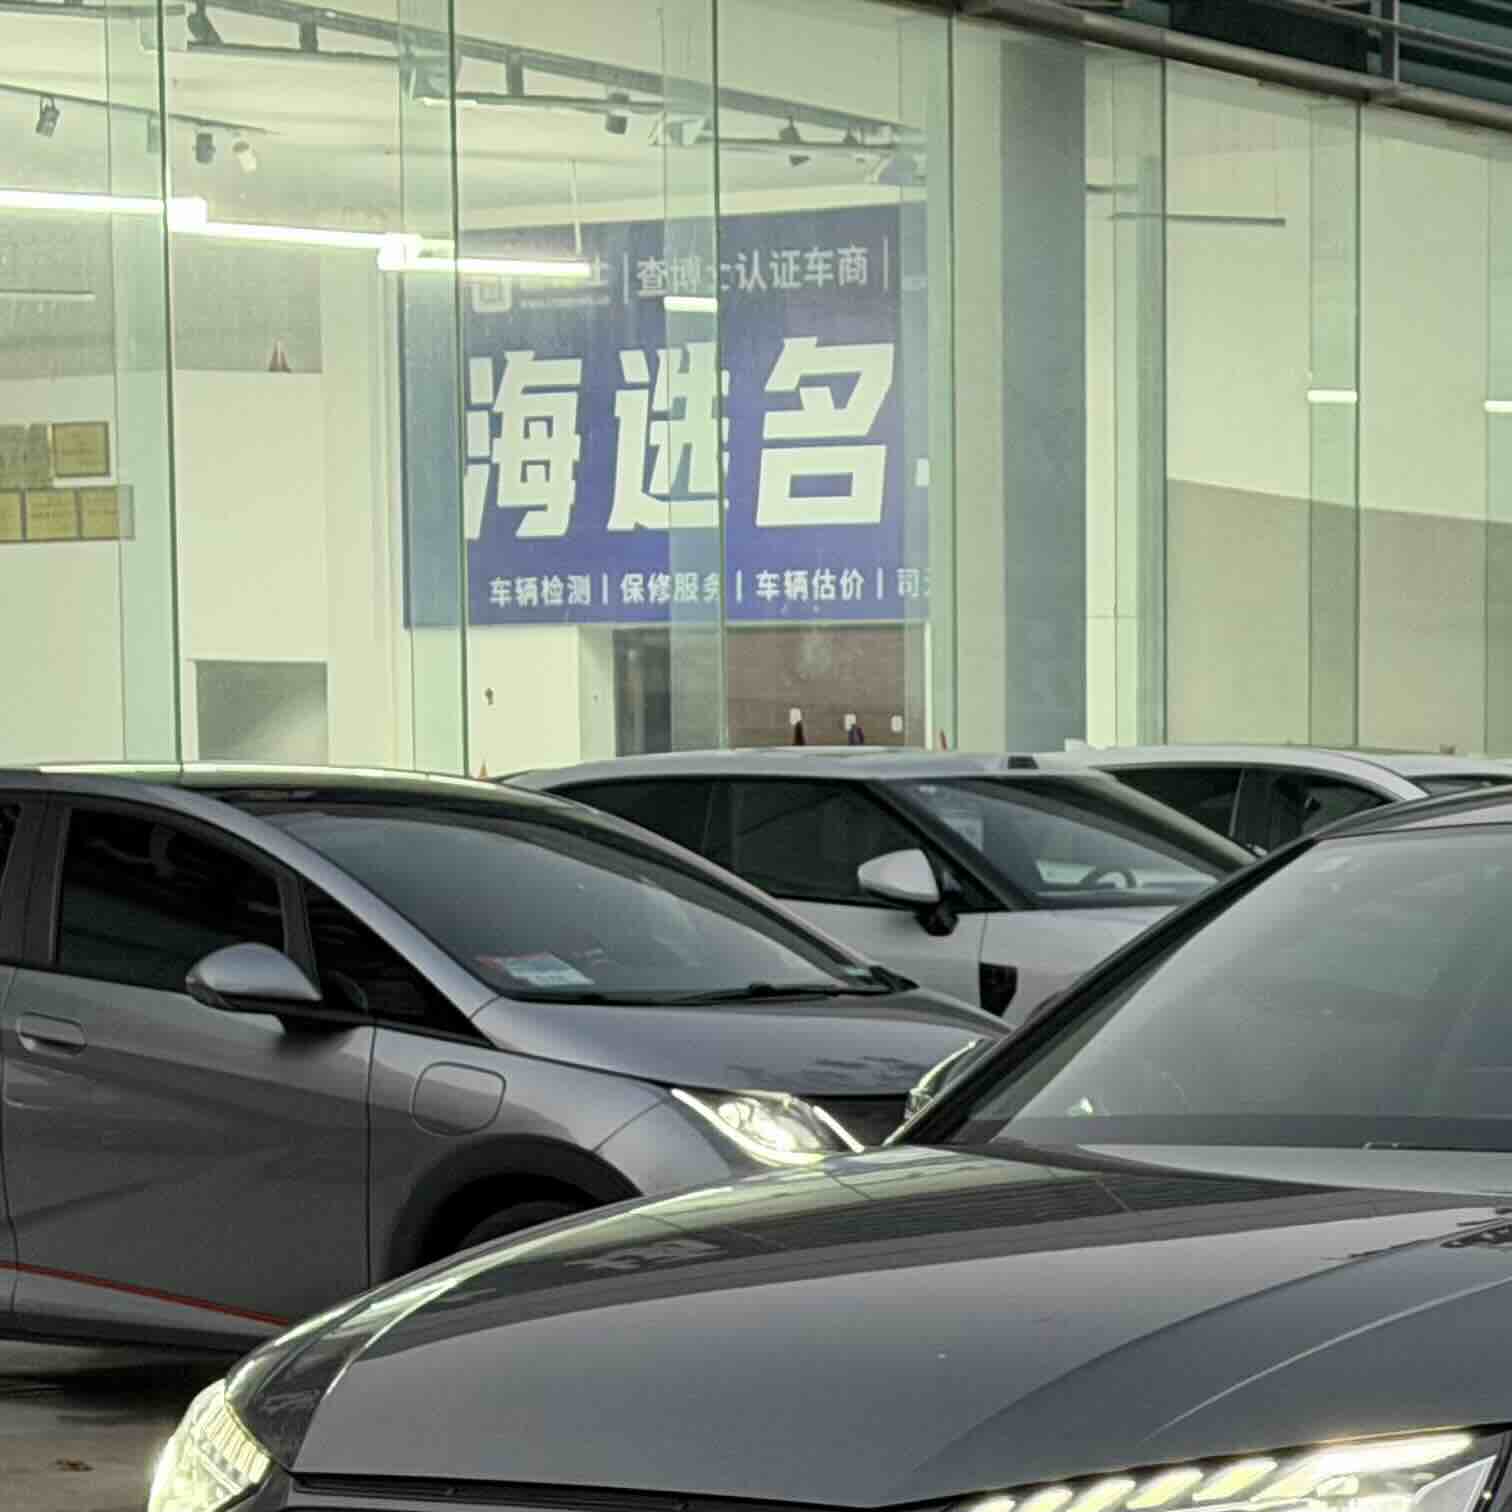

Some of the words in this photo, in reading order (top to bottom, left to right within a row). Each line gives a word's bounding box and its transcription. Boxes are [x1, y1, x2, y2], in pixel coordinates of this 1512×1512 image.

[464, 336, 930, 541] 海选名
[488, 574, 593, 608] 车辆检测
[620, 571, 724, 605] 保修服务
[755, 567, 865, 602] 车辆估价
